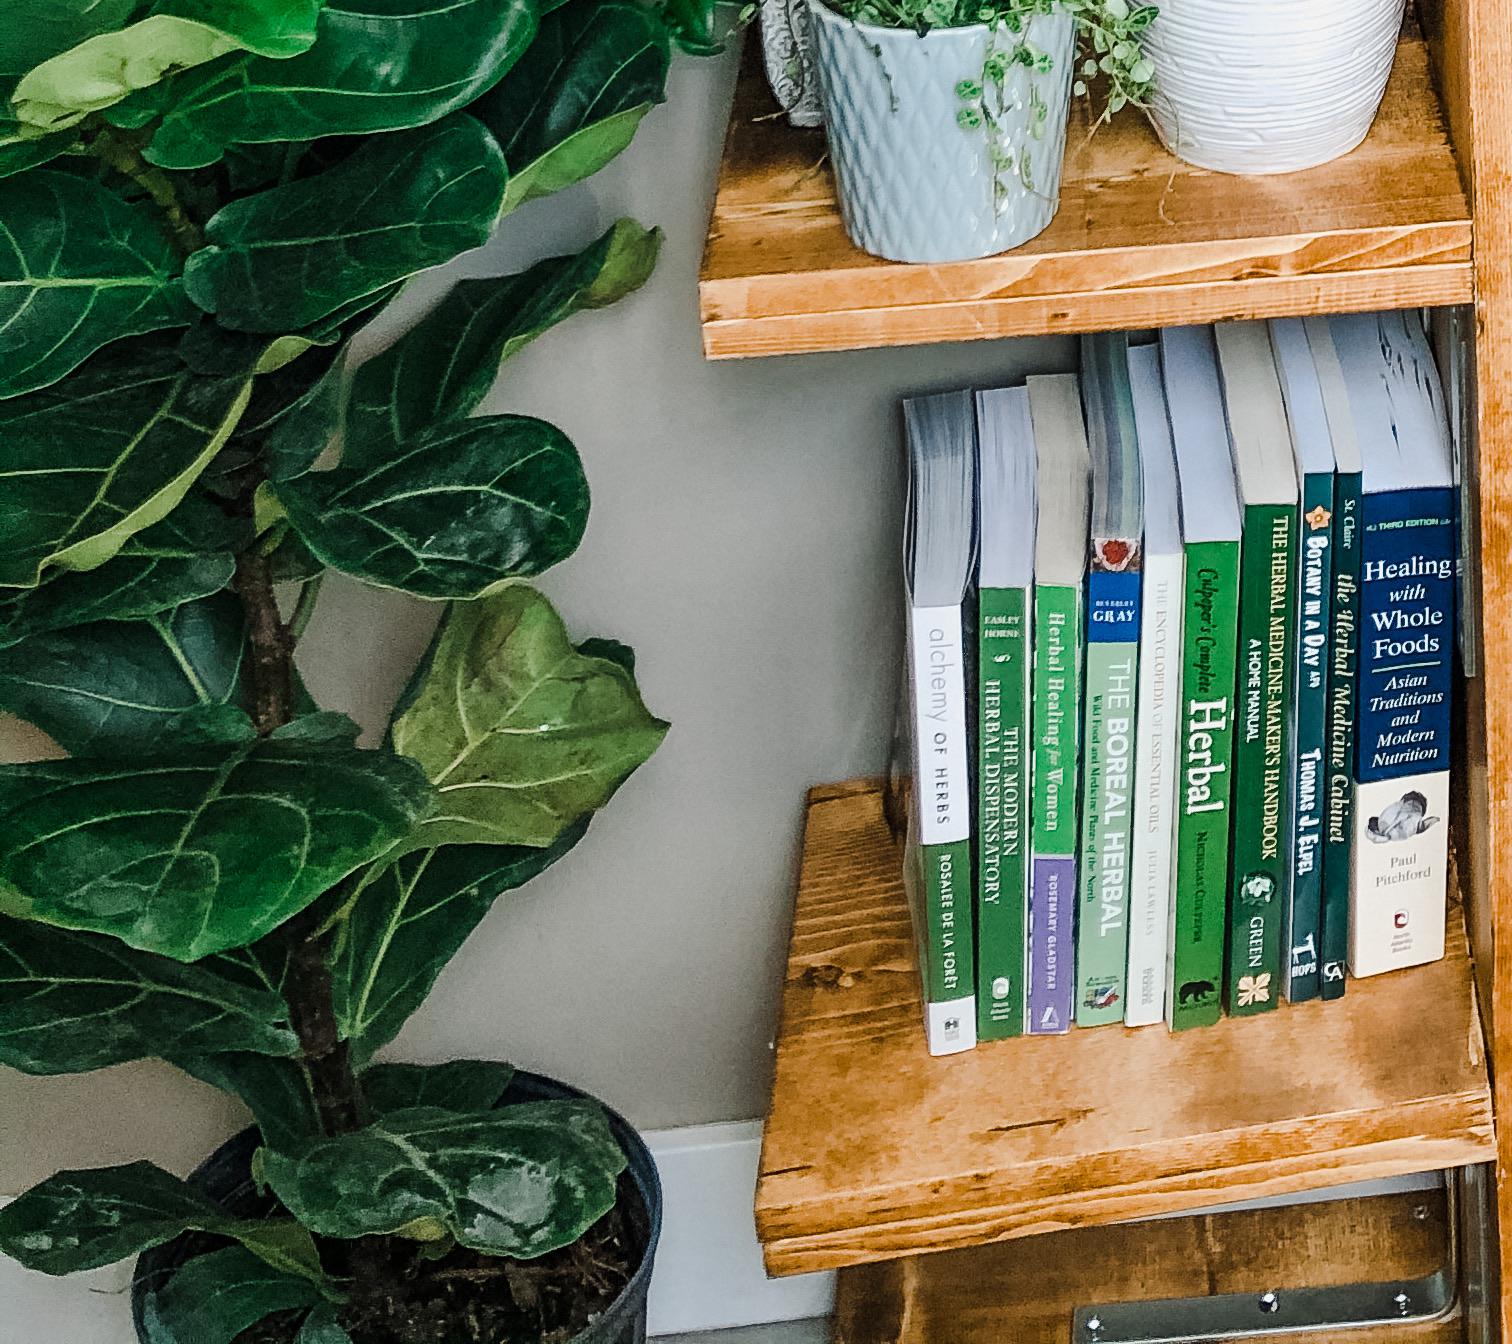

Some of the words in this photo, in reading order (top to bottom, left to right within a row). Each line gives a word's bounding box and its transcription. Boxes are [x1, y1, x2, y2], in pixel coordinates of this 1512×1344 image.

[1344, 499, 1355, 513] St.
[1272, 515, 1289, 548] THE
[1344, 516, 1355, 549] Claire
[1379, 519, 1404, 531] THIRD
[1405, 517, 1439, 528] EDITION
[1270, 552, 1288, 613] HERBAL
[1364, 555, 1451, 582] Healing
[1156, 581, 1168, 606] THE
[1195, 568, 1218, 635] Culpeper's
[1389, 584, 1425, 602] with
[1093, 610, 1135, 623] GRAY
[1371, 607, 1443, 632] Whole
[1048, 612, 1065, 671] Herbal
[1250, 639, 1261, 649] A
[1334, 608, 1355, 677] Herbal
[1372, 634, 1440, 659] Foods
[927, 627, 953, 722] alchemy
[1152, 610, 1167, 710] ENCYCLOPEDIA
[1193, 636, 1217, 693] Complete
[1248, 651, 1261, 690] HOME
[1107, 659, 1131, 709] THE
[1264, 616, 1286, 767] MEDICINE-MAKER'S
[1384, 674, 1427, 691] Asian
[1042, 678, 1064, 745] Healing
[1092, 695, 1102, 716] Wild
[1246, 691, 1260, 743] MANUAL
[1370, 690, 1443, 712] Traditions
[983, 678, 1001, 759] HERBAL
[1092, 719, 1102, 744] Food
[1152, 714, 1164, 729] OF
[1331, 684, 1352, 769] Medicine
[1391, 710, 1419, 726] and
[933, 732, 947, 755] OF
[1003, 726, 1018, 767] THE
[1091, 746, 1101, 764] and
[1376, 729, 1434, 749] Modern
[1103, 718, 1129, 825] BOREAL
[1150, 733, 1162, 801] ESSENTIAL
[1187, 697, 1227, 815] Herbal
[1372, 747, 1438, 768] Nutrition
[935, 767, 950, 825] HERBS
[1046, 768, 1063, 831] Women
[1089, 768, 1100, 812] Medicine
[1003, 772, 1019, 856] MODERN
[1148, 804, 1160, 833] OILS
[1261, 769, 1280, 860] HANDBOOK
[1298, 814, 1320, 831] J.
[1329, 774, 1350, 842] Cabinet
[983, 763, 1001, 904] DISPENSATORY
[1085, 844, 1098, 854] of
[1087, 857, 1097, 872] the
[1147, 850, 1158, 881] JULIA
[1375, 867, 1431, 887] Pitchford
[1390, 853, 1417, 868] Paul
[939, 854, 954, 908] ROSALEE
[1086, 875, 1097, 903] North
[1100, 832, 1125, 937] HERBAL
[1047, 873, 1058, 932] ROSEMARY
[1145, 886, 1157, 936] LAWLESS
[942, 912, 954, 929] DE
[942, 932, 954, 948] LA
[1249, 916, 1264, 968] GREEN
[1046, 936, 1058, 990] GLADSTAR
[1292, 963, 1316, 977] HOPS
